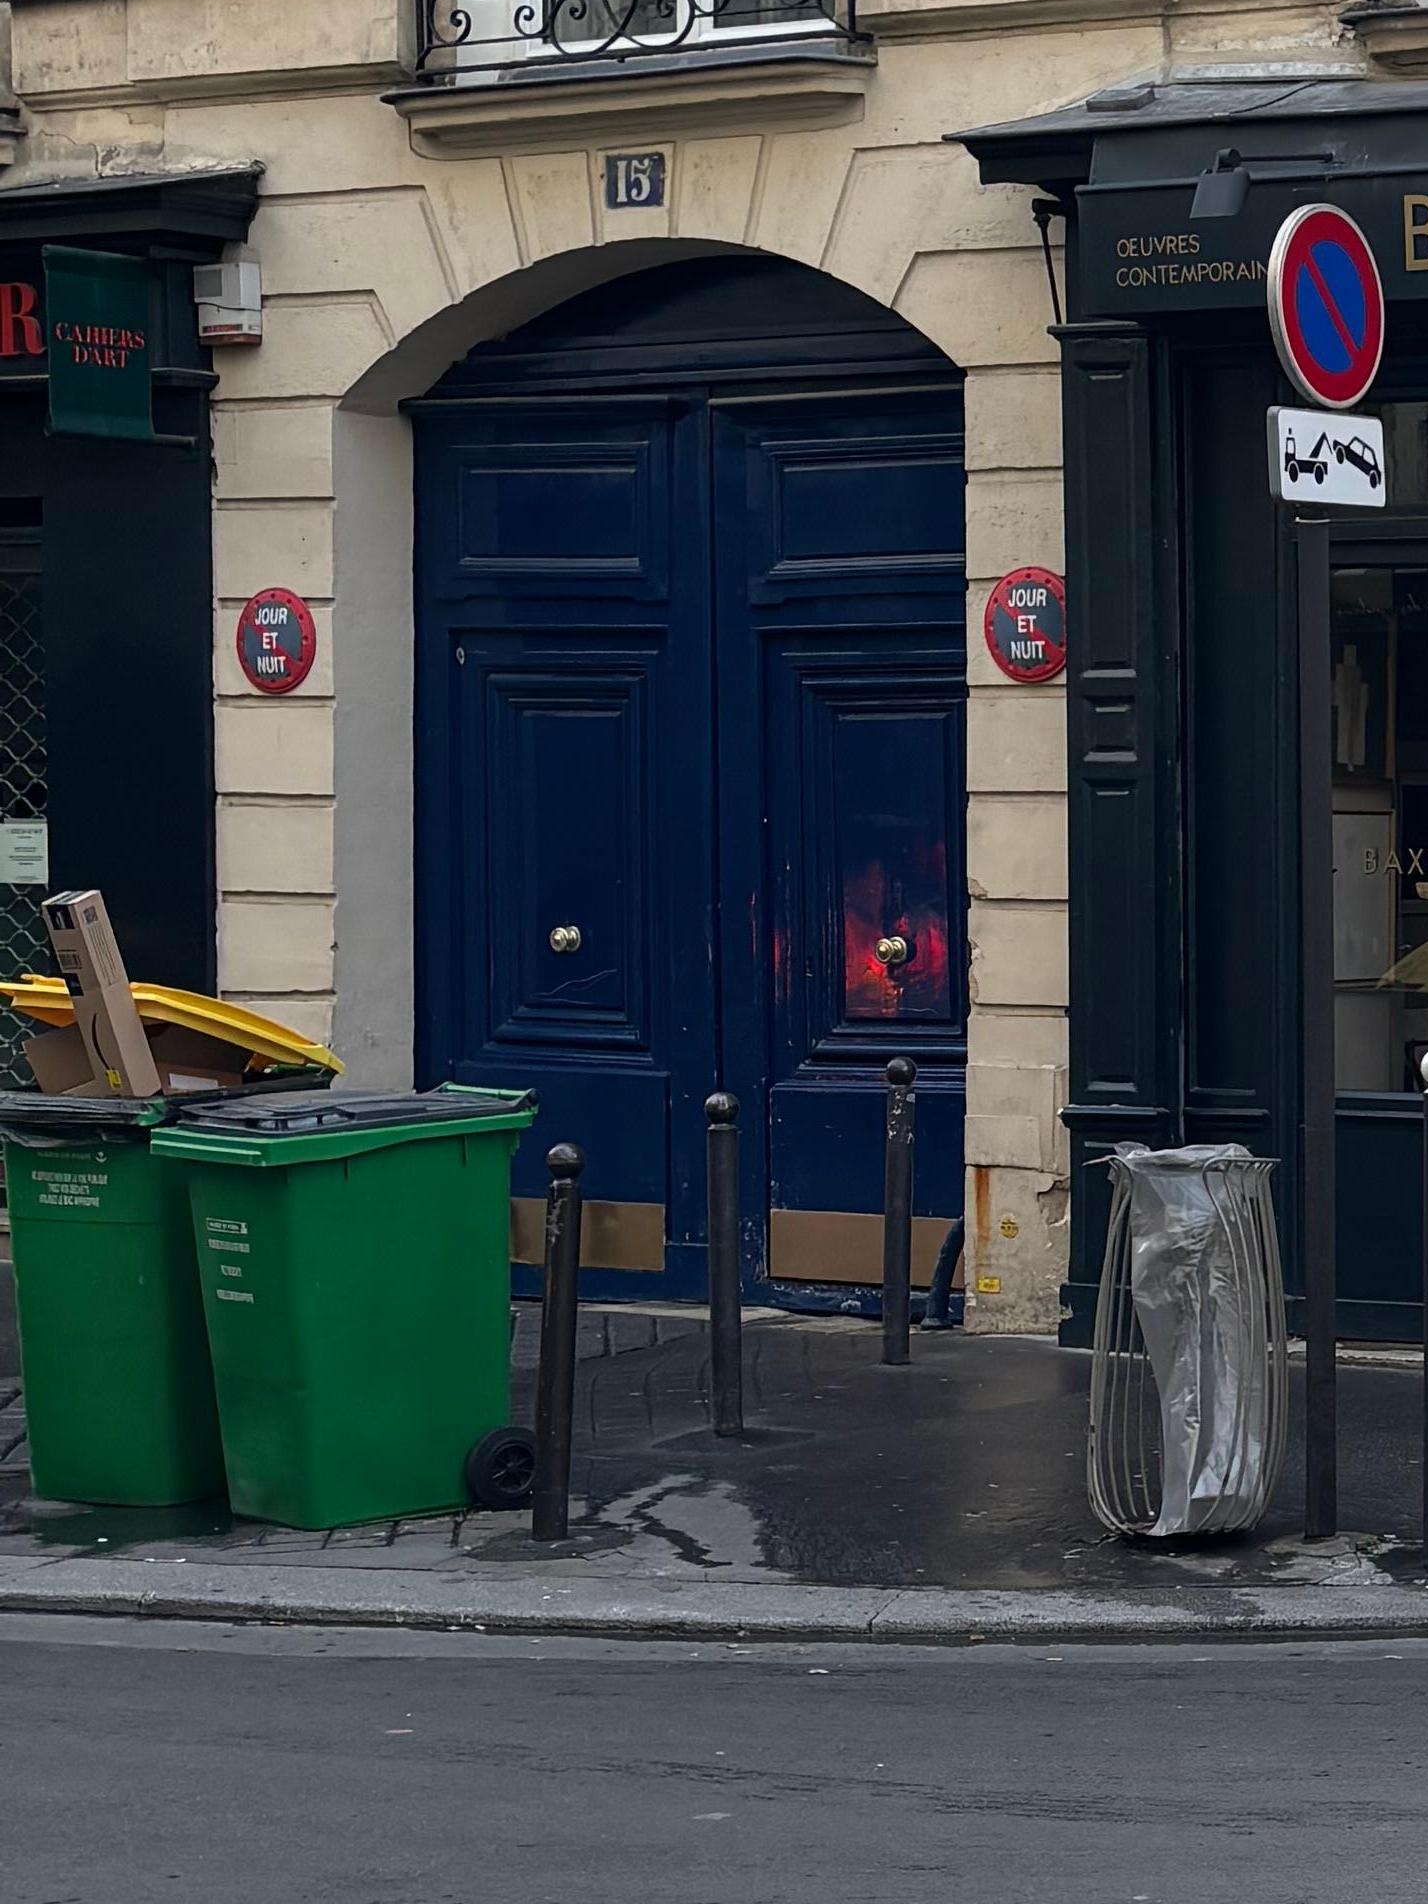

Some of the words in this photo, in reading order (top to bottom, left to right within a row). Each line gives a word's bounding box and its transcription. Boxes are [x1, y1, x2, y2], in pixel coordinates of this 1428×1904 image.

[616, 158, 652, 203] 15
[1116, 234, 1200, 258] OEUVRES
[1008, 589, 1047, 608] JOUR
[254, 607, 288, 626] JOUR
[1017, 615, 1036, 633] ET
[262, 632, 278, 649] ET
[1010, 641, 1045, 659] NUIT
[257, 656, 286, 674] NUIT
